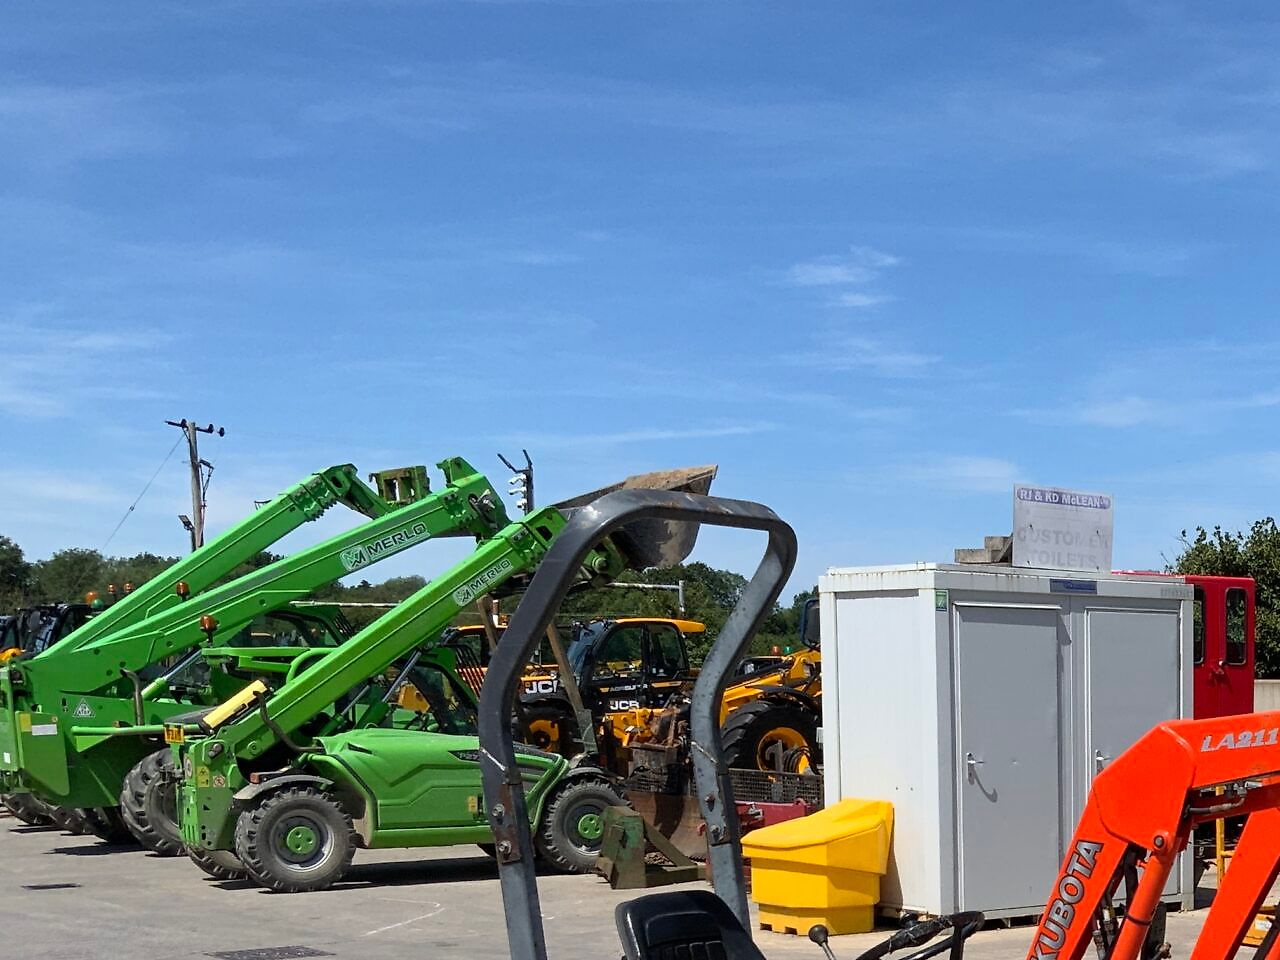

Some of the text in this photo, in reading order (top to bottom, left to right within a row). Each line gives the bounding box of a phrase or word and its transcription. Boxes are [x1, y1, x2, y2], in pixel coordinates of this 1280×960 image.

[1035, 491, 1043, 501] &
[1045, 492, 1059, 503] KD
[1061, 494, 1100, 508] McLEAN
[367, 521, 427, 556] MERLO
[470, 558, 511, 590] MERLO
[1200, 727, 1280, 752] LA211
